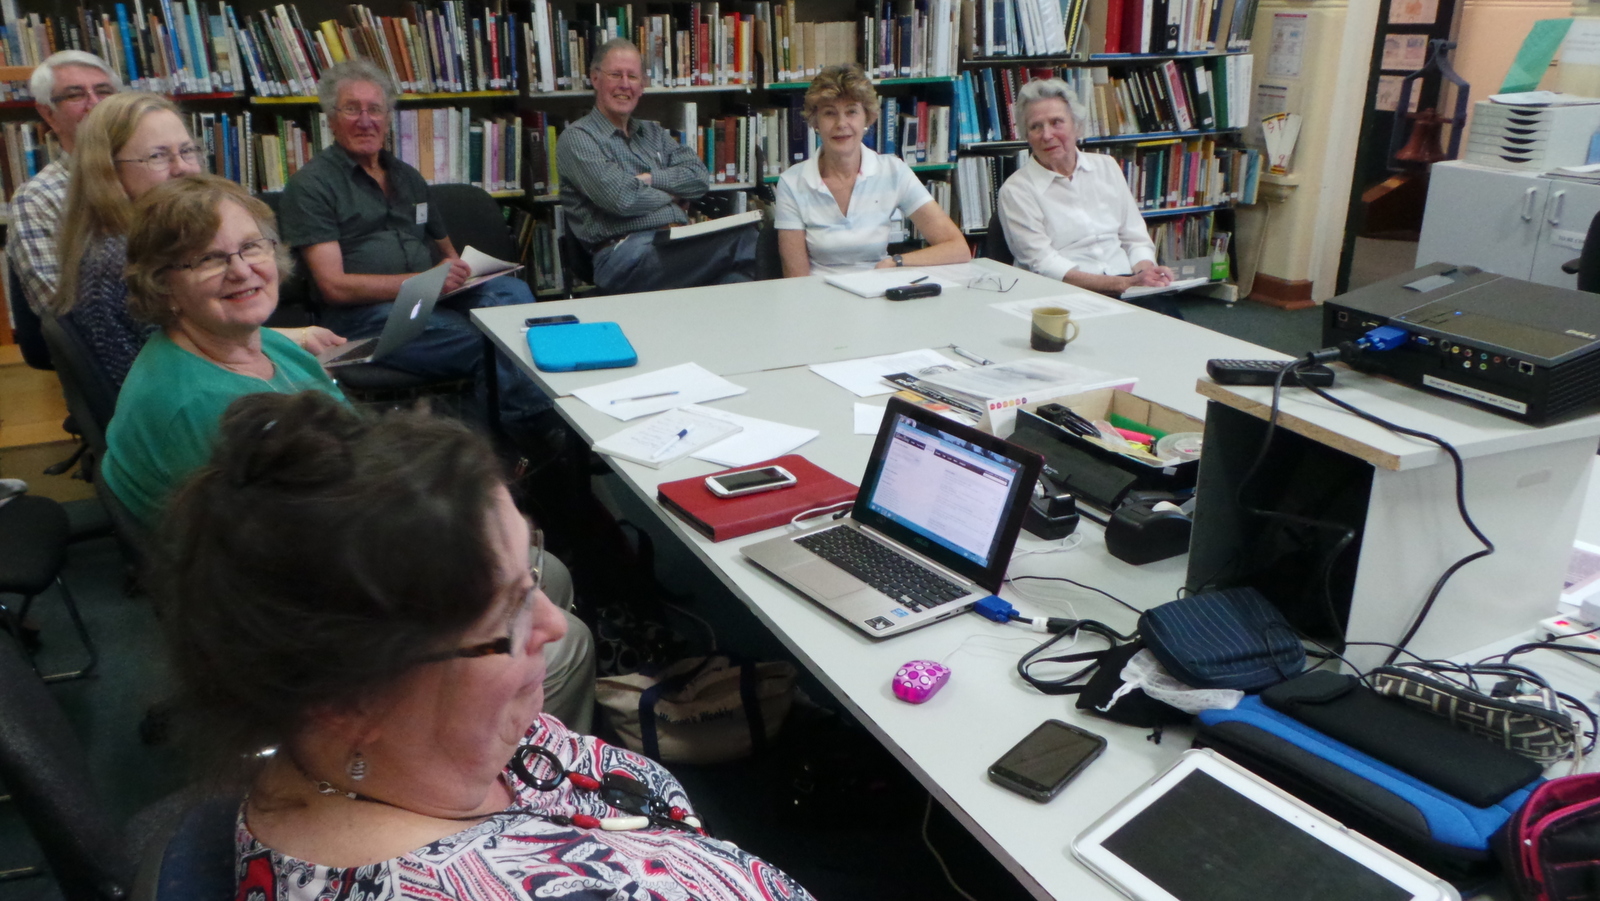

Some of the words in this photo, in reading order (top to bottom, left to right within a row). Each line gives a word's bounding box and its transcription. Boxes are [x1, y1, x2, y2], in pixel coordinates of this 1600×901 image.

[887, 100, 896, 142] HERALDRY
[1565, 329, 1597, 339] DELL
[699, 706, 734, 723] Weekly
